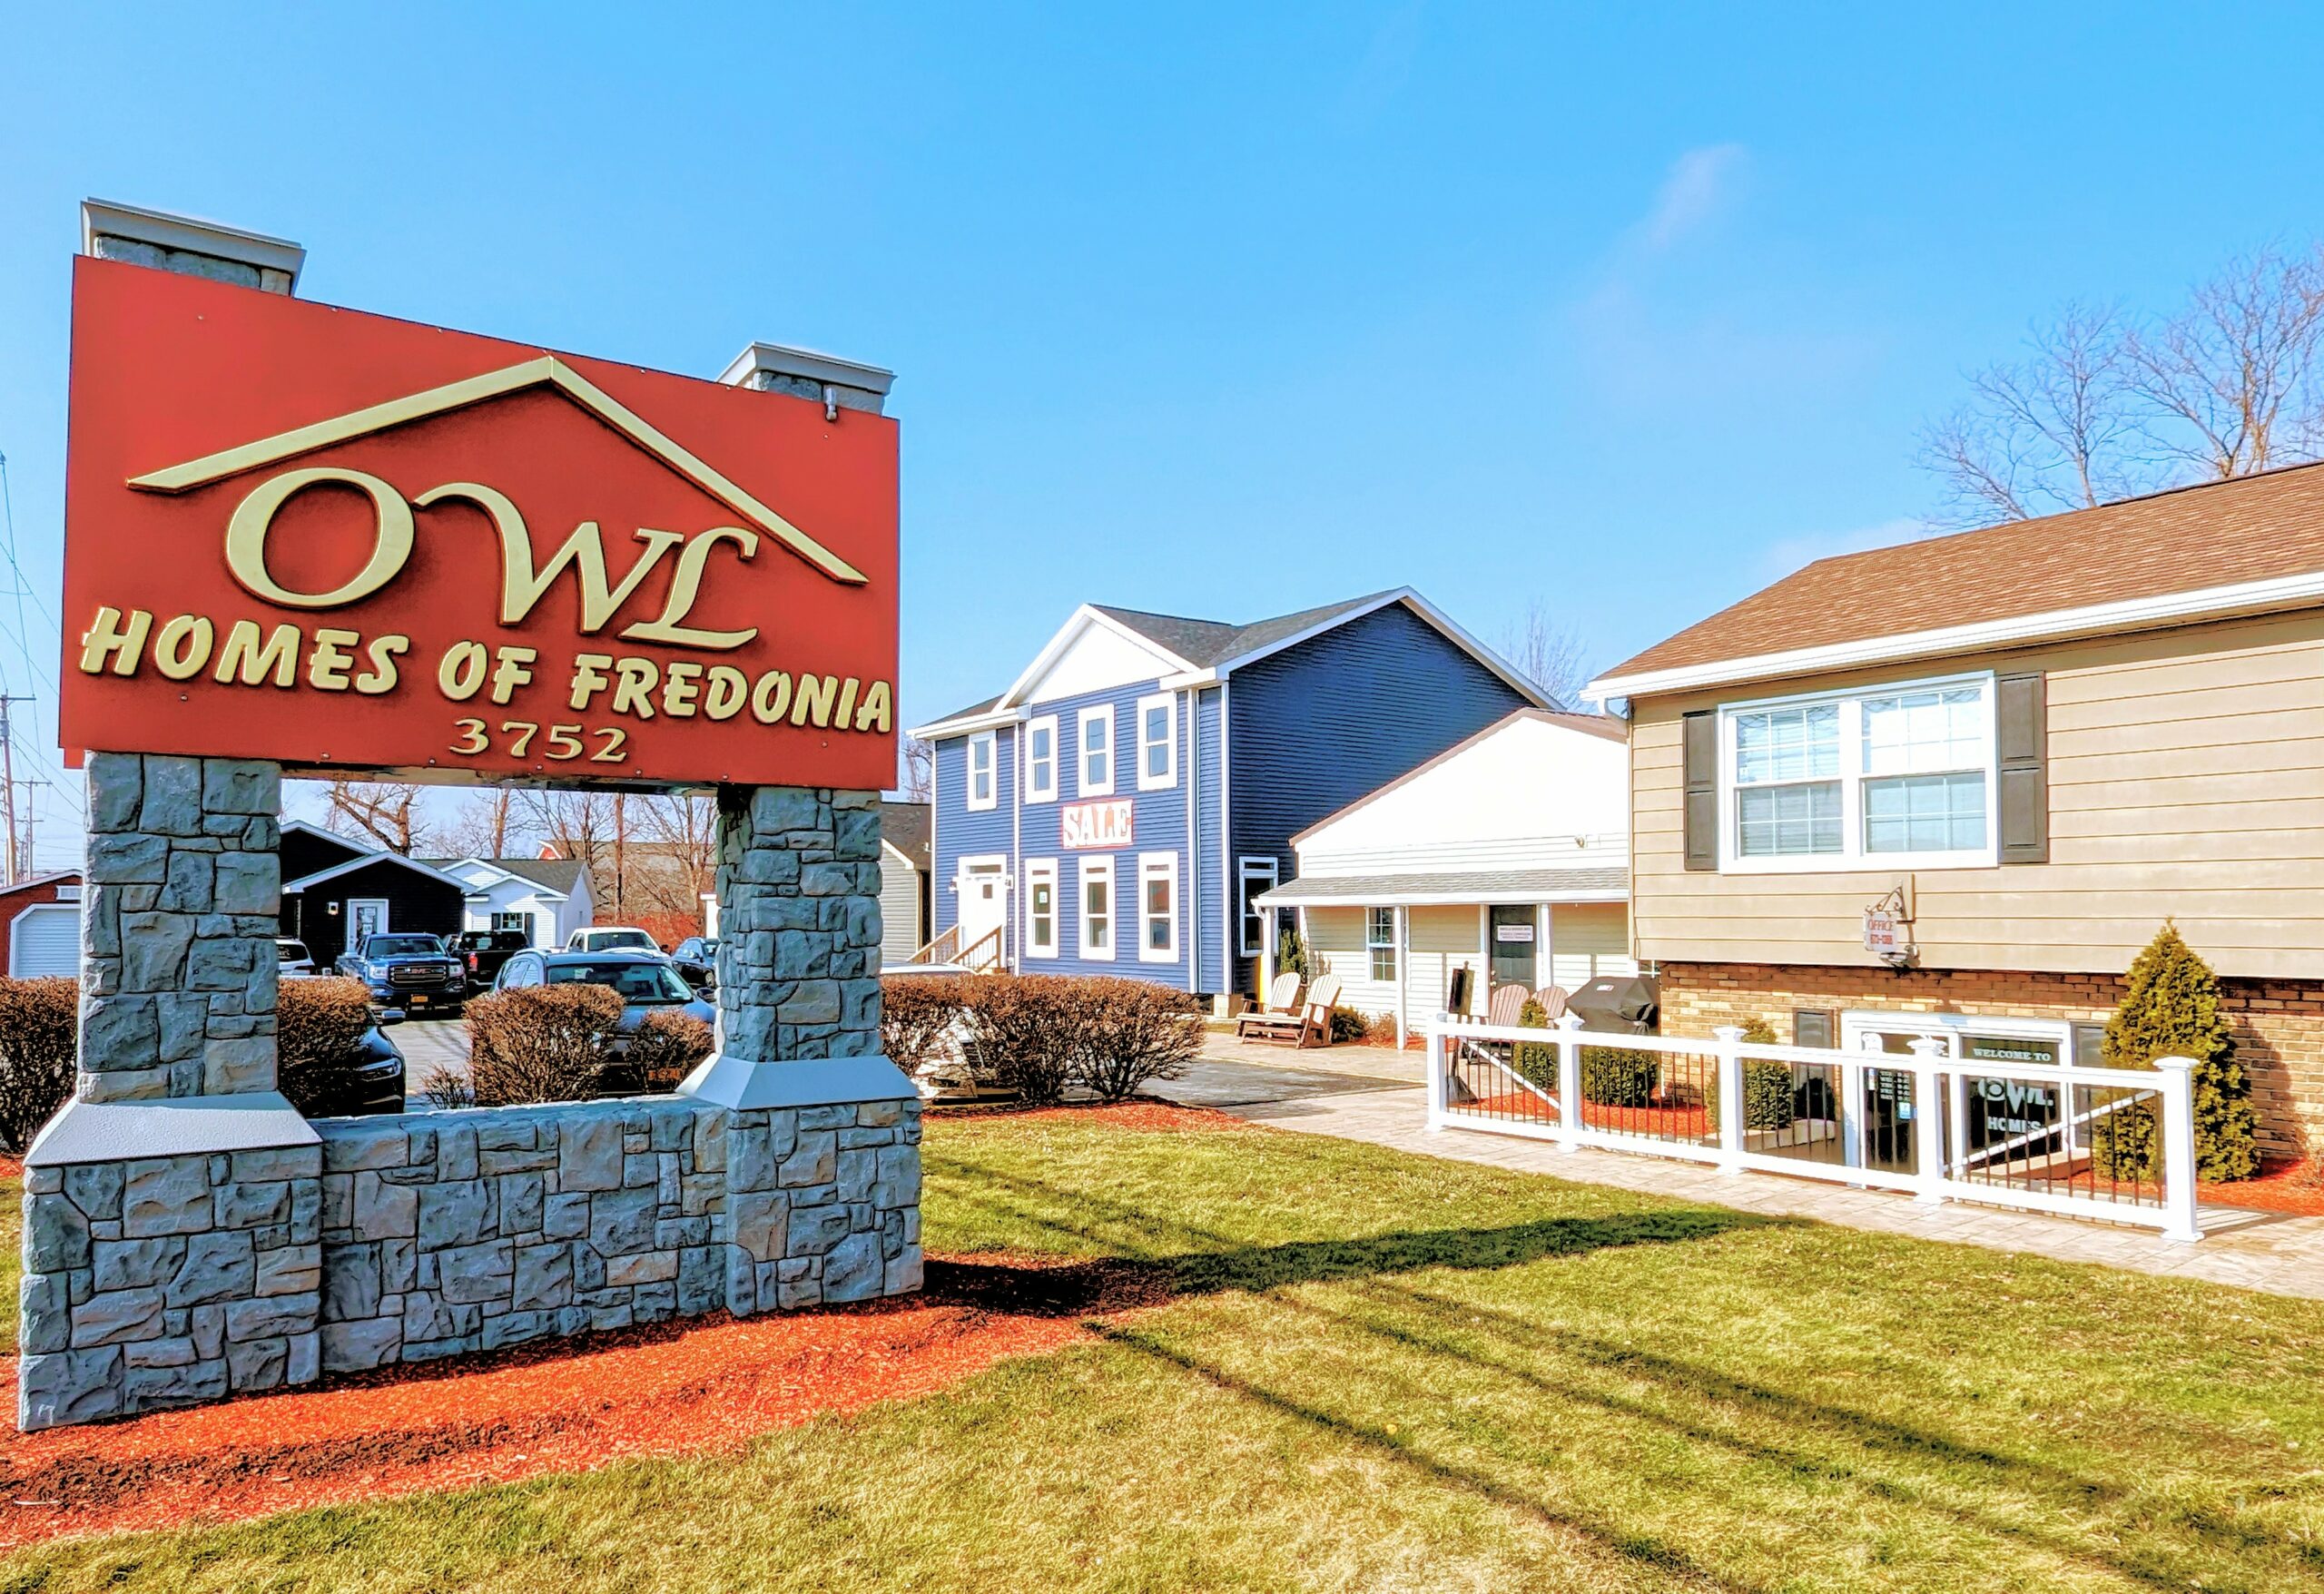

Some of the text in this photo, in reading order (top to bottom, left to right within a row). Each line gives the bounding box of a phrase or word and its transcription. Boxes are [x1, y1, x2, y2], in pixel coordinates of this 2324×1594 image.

[225, 467, 760, 651] OWL
[80, 606, 892, 733] HOMES OF FREDONIA
[448, 718, 628, 763] 3752
[1063, 802, 1132, 847] SALE
[1867, 919, 1894, 931] OFFICE
[1973, 1048, 2052, 1061] WELCOME TO
